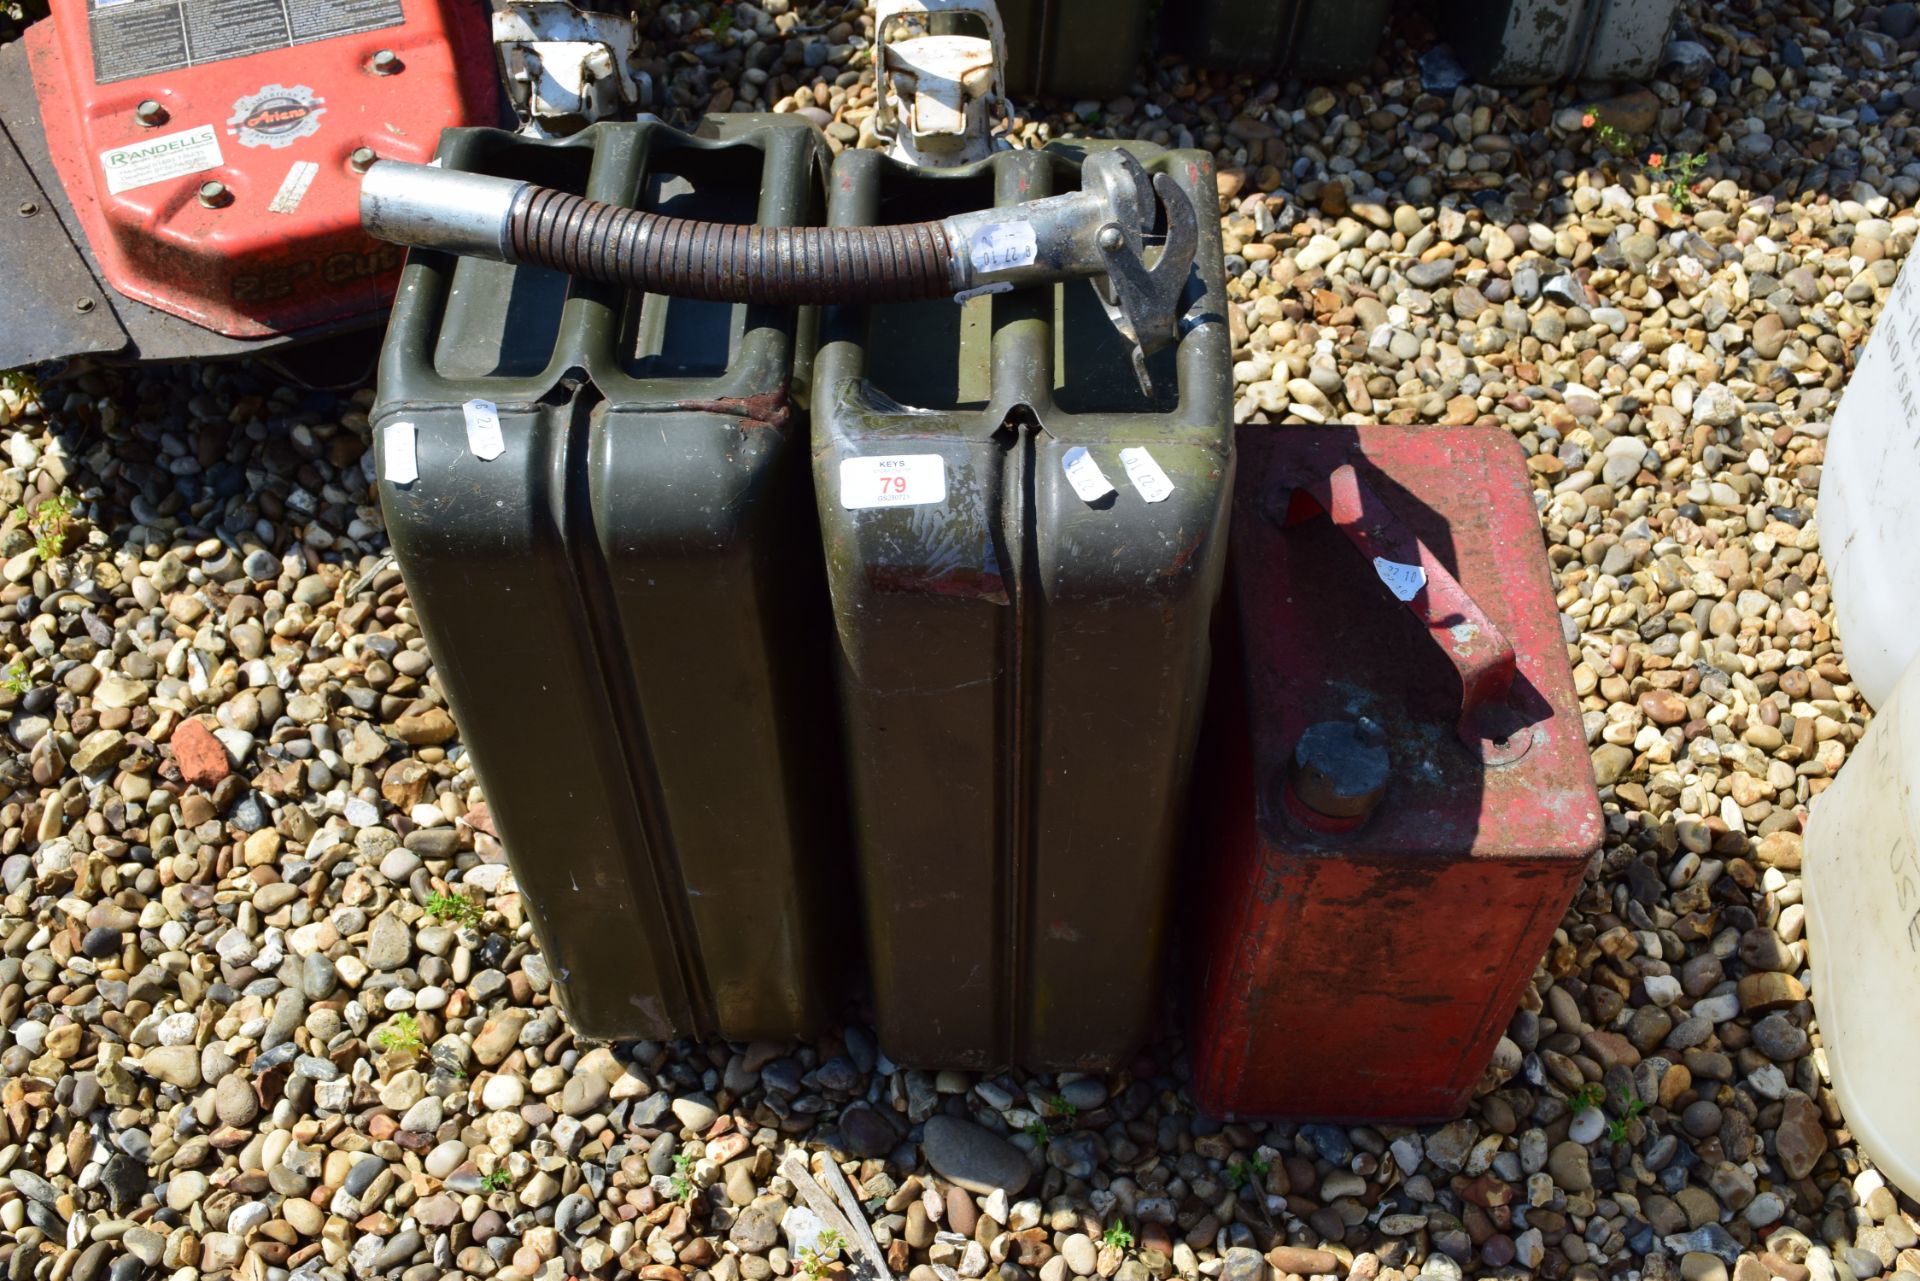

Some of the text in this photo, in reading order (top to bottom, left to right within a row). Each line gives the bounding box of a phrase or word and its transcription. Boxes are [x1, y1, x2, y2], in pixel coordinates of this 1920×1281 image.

[247, 108, 306, 127] Ariens
[110, 132, 214, 165] RANDELLS
[1885, 314, 1918, 429] ISO/SAE
[879, 460, 905, 468] KEYS
[879, 476, 906, 494] 79
